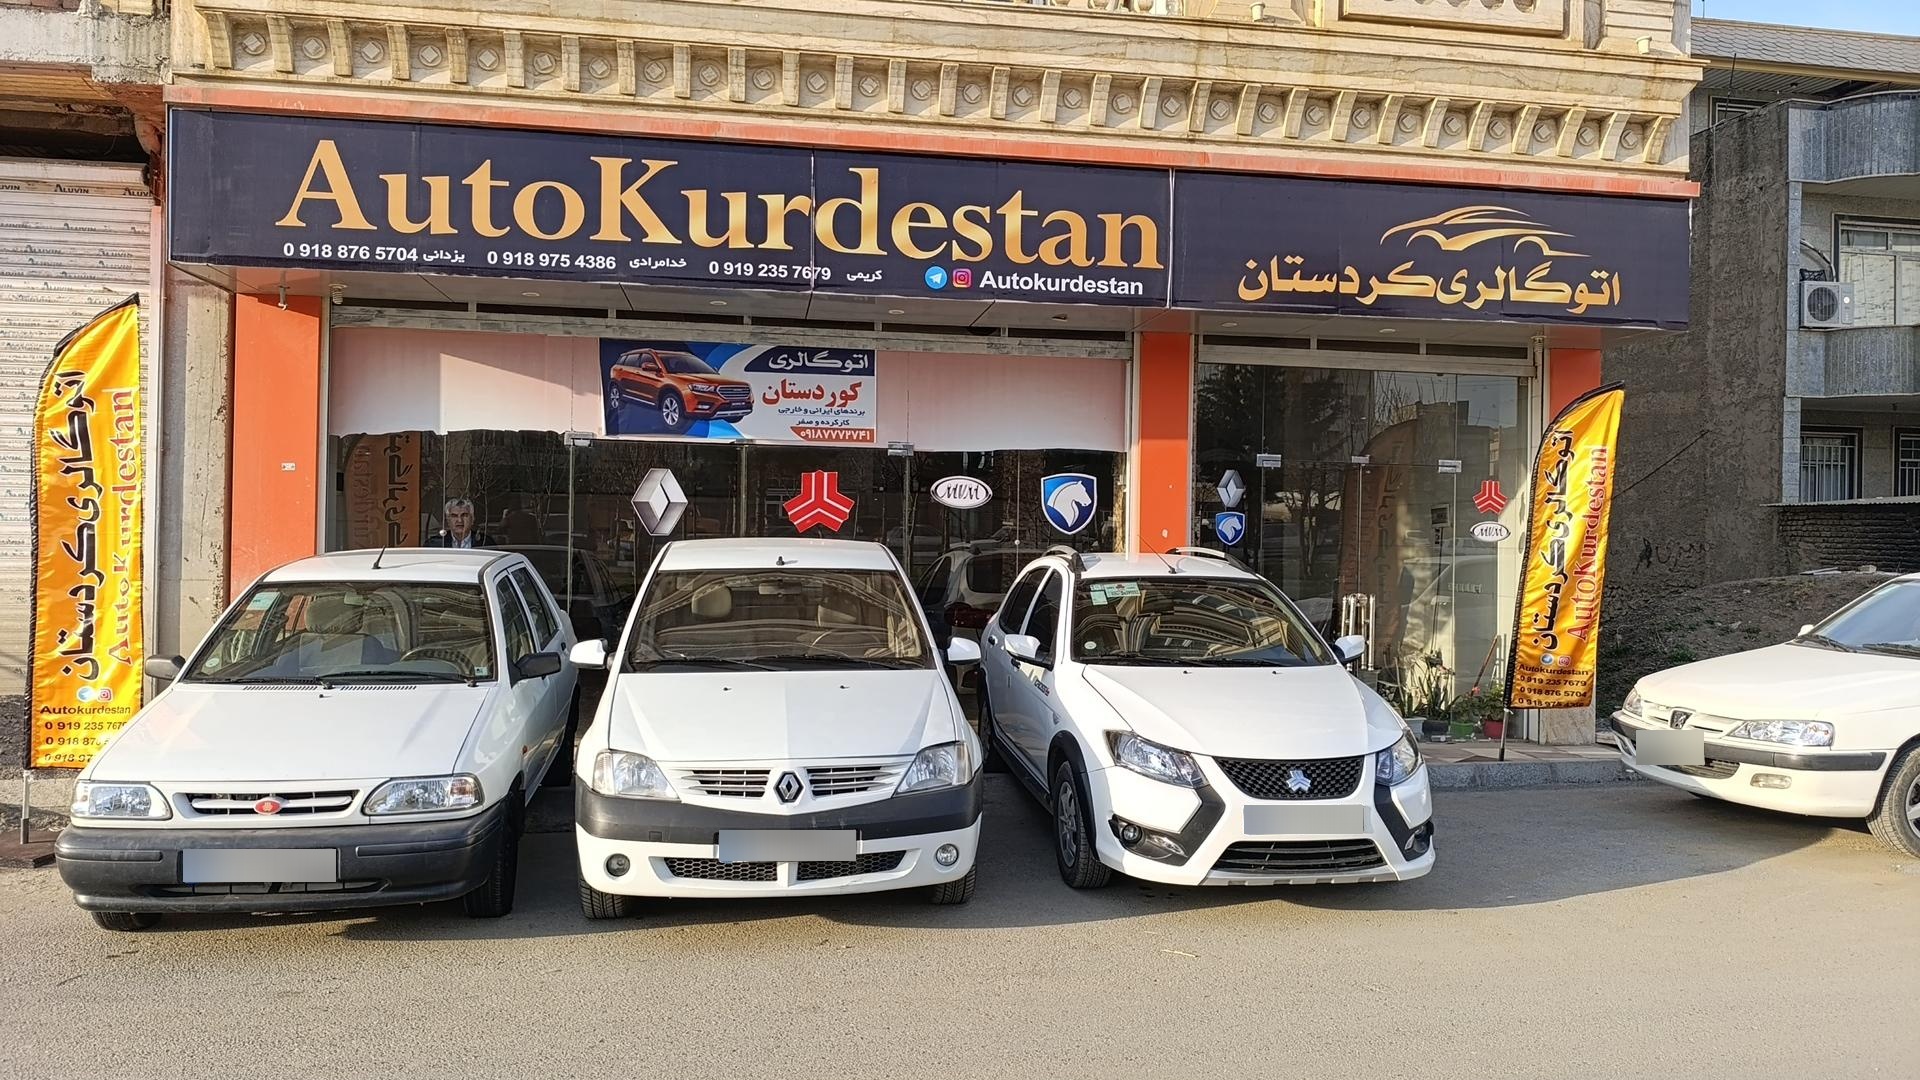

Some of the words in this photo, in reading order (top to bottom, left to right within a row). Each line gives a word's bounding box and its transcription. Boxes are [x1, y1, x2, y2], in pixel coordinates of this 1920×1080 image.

[54, 184, 89, 194] ALUVIN
[275, 139, 1164, 270] AutoKurdestan
[283, 243, 294, 256] 0
[299, 244, 333, 258] 918
[337, 245, 370, 259] 876
[375, 247, 419, 262] 5704
[423, 249, 465, 263] یزدانی
[486, 251, 498, 264] 0
[503, 252, 535, 266] 918
[537, 253, 570, 267] 975
[574, 254, 617, 269] 4386
[629, 257, 687, 269] خدامرادی
[708, 261, 719, 274] 0
[723, 262, 753, 276] 919
[758, 263, 788, 278] 235
[792, 265, 832, 280] 7679
[846, 269, 883, 281] کریمی
[979, 270, 1144, 296] Autokurdestan
[768, 350, 869, 372] اتوگالری
[762, 379, 863, 407] کوردستان
[1567, 446, 1608, 642] AutoKurdestan
[1519, 664, 1589, 676] Autokurdestan
[1527, 676, 1544, 684] 919
[1527, 688, 1543, 696] 918
[1563, 690, 1587, 698] 5704
[40, 706, 131, 715] Autokurdestan
[45, 722, 53, 730] 0
[57, 722, 81, 730] 919
[84, 722, 104, 730] 235
[45, 737, 54, 745] 0
[57, 737, 80, 745] 918
